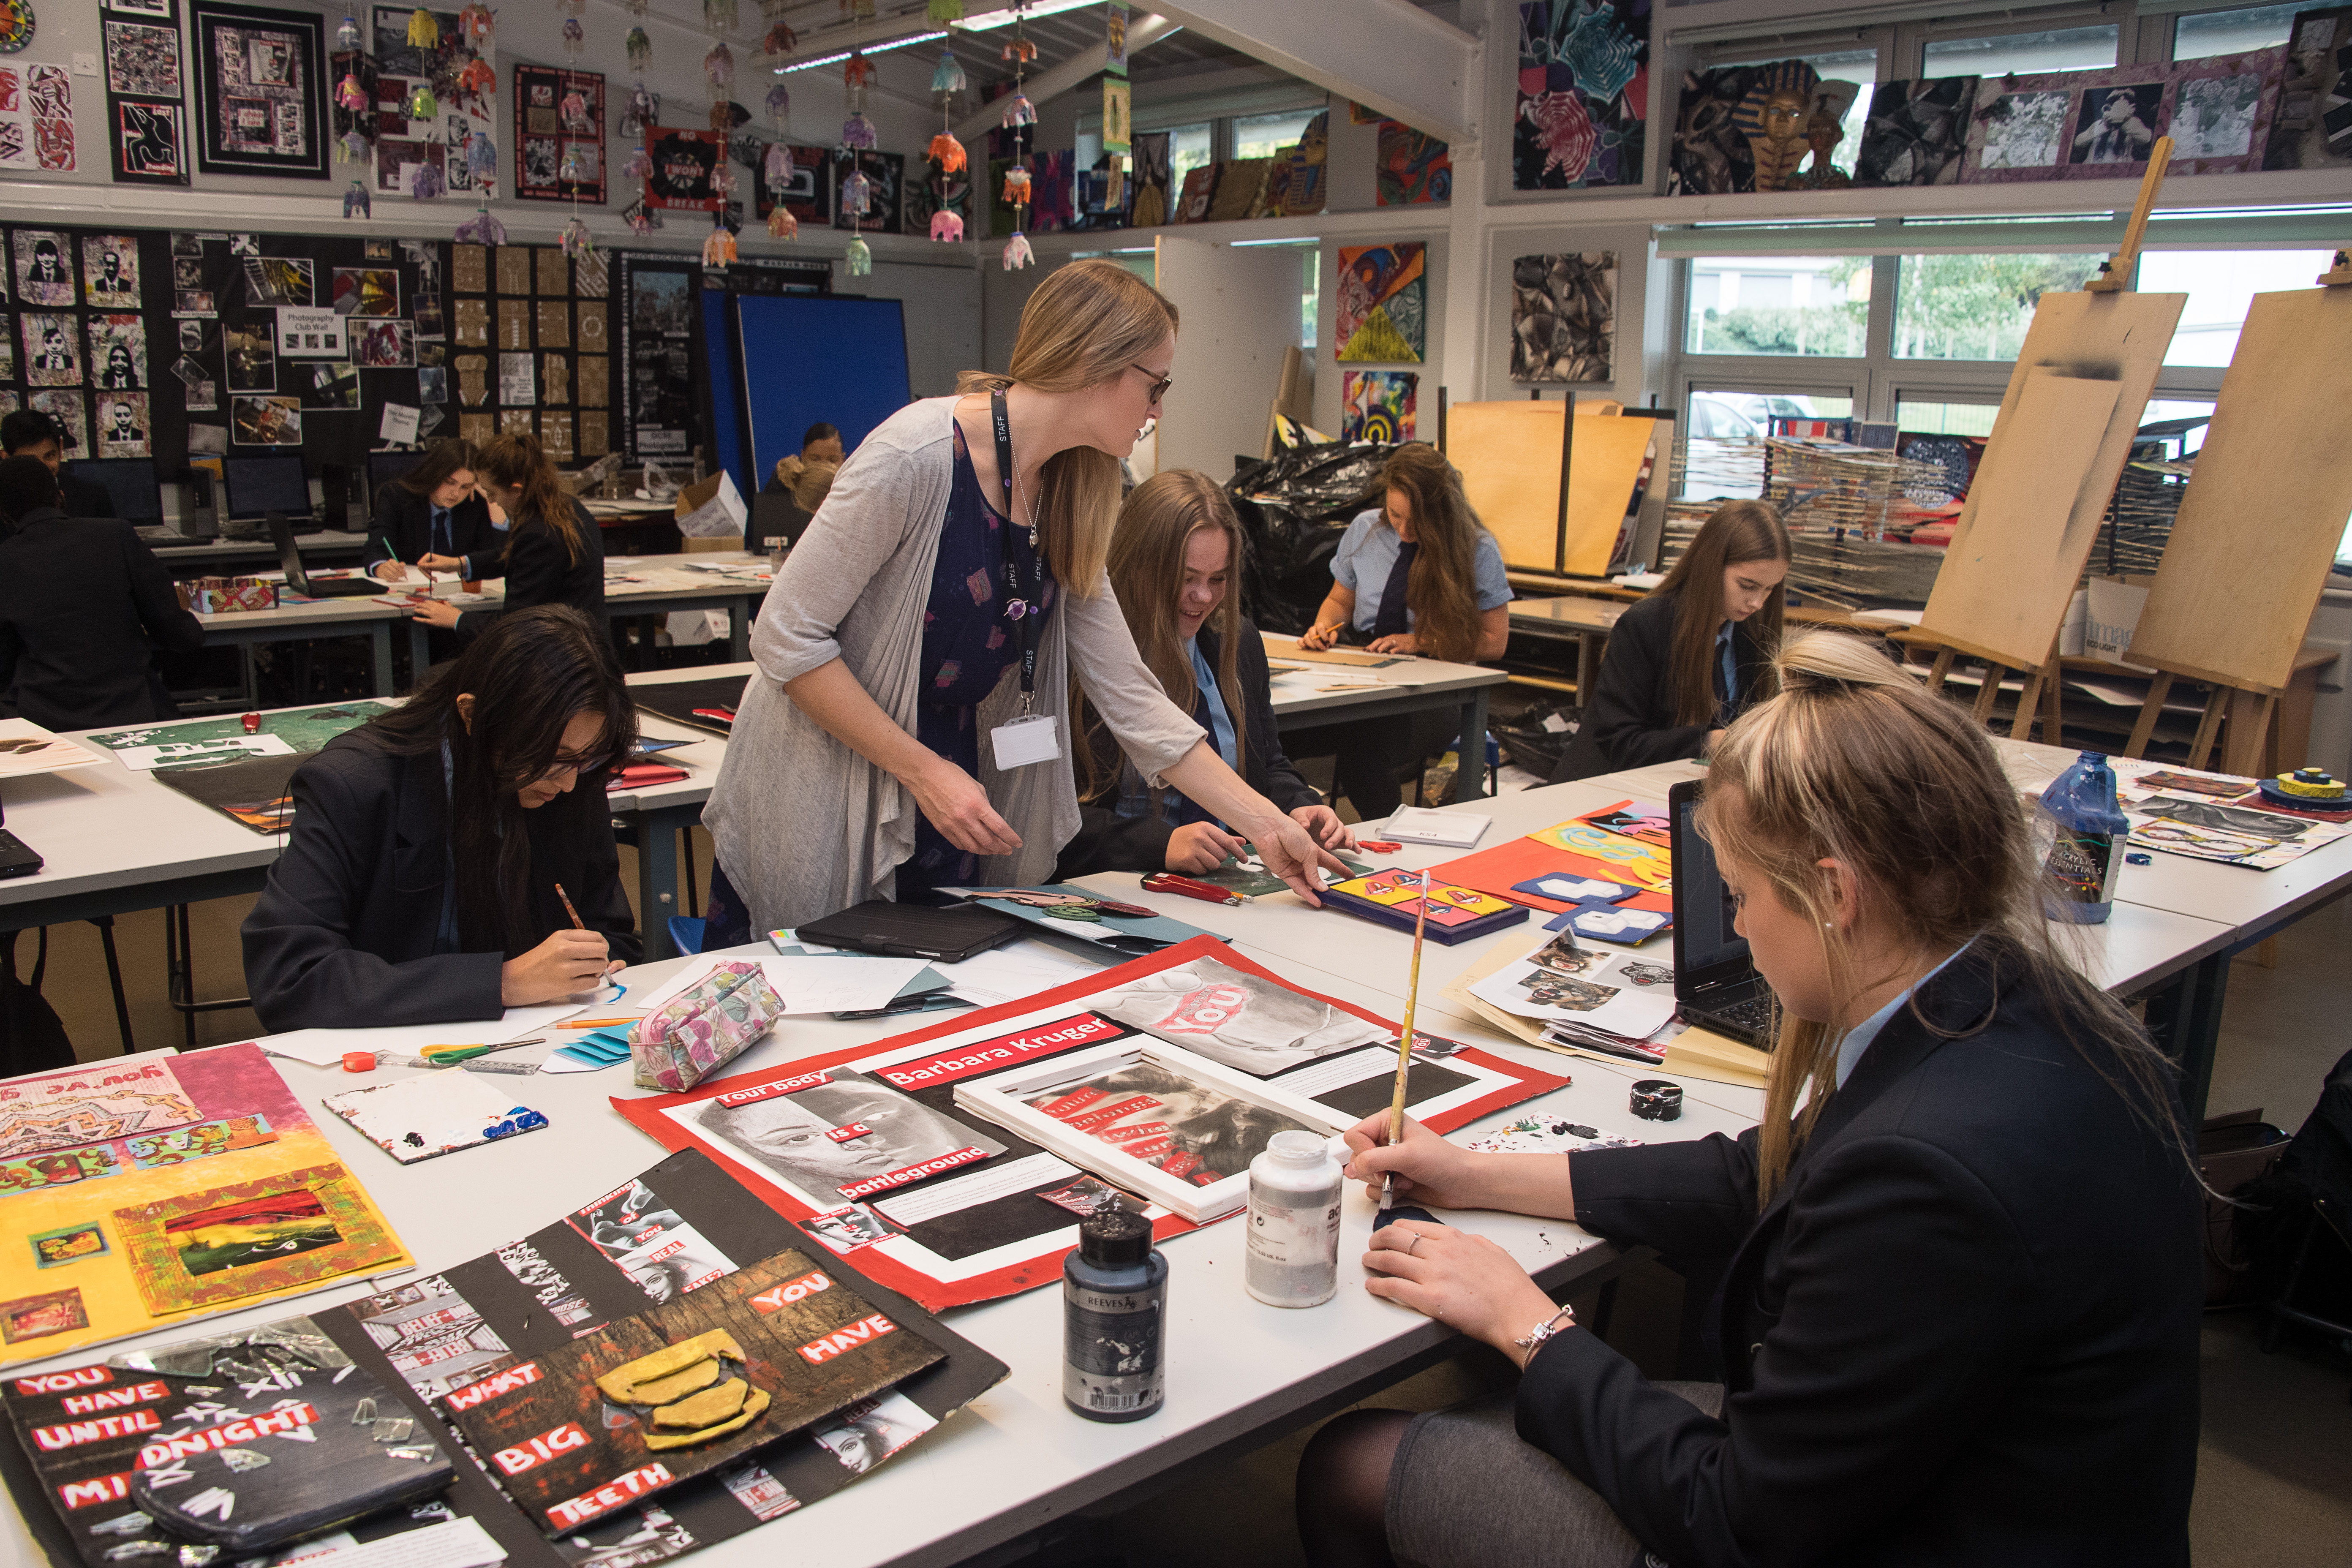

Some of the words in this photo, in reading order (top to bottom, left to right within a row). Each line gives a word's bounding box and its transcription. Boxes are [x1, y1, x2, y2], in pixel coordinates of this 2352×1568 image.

[680, 131, 697, 139] NO
[667, 199, 705, 208] BREAK
[288, 314, 334, 323] Photography
[295, 323, 311, 331] Club
[997, 416, 1007, 442] STAFF
[1009, 563, 1017, 588] STAFF
[2087, 639, 2099, 650] ECO
[2099, 642, 2118, 653] LIGHT
[885, 1047, 1013, 1085] Barbara
[1009, 1017, 1108, 1052] Kruger
[720, 1085, 773, 1105] Your
[772, 1070, 828, 1093] body
[829, 1125, 851, 1140] is
[851, 1123, 869, 1135] a
[836, 1146, 987, 1200] battleground
[1056, 1195, 1089, 1204] belongs
[623, 1211, 637, 1224] of
[811, 1214, 830, 1222] Your
[831, 1206, 851, 1216] body
[636, 1225, 662, 1241] You
[846, 1232, 898, 1252] battleground
[651, 1241, 684, 1262] REAL
[754, 1271, 831, 1311] YOU
[1088, 1296, 1123, 1308] REEVES
[802, 1315, 896, 1364] HAVE
[19, 1367, 106, 1394] YOU
[448, 1363, 537, 1410] WHAT
[64, 1383, 163, 1414] HAVE
[846, 1399, 880, 1422] REAL
[35, 1412, 161, 1449] UNTIL
[879, 1425, 890, 1433] OR
[498, 1426, 586, 1475] BIG
[63, 1475, 128, 1509] MI
[553, 1462, 672, 1524] TEETH
